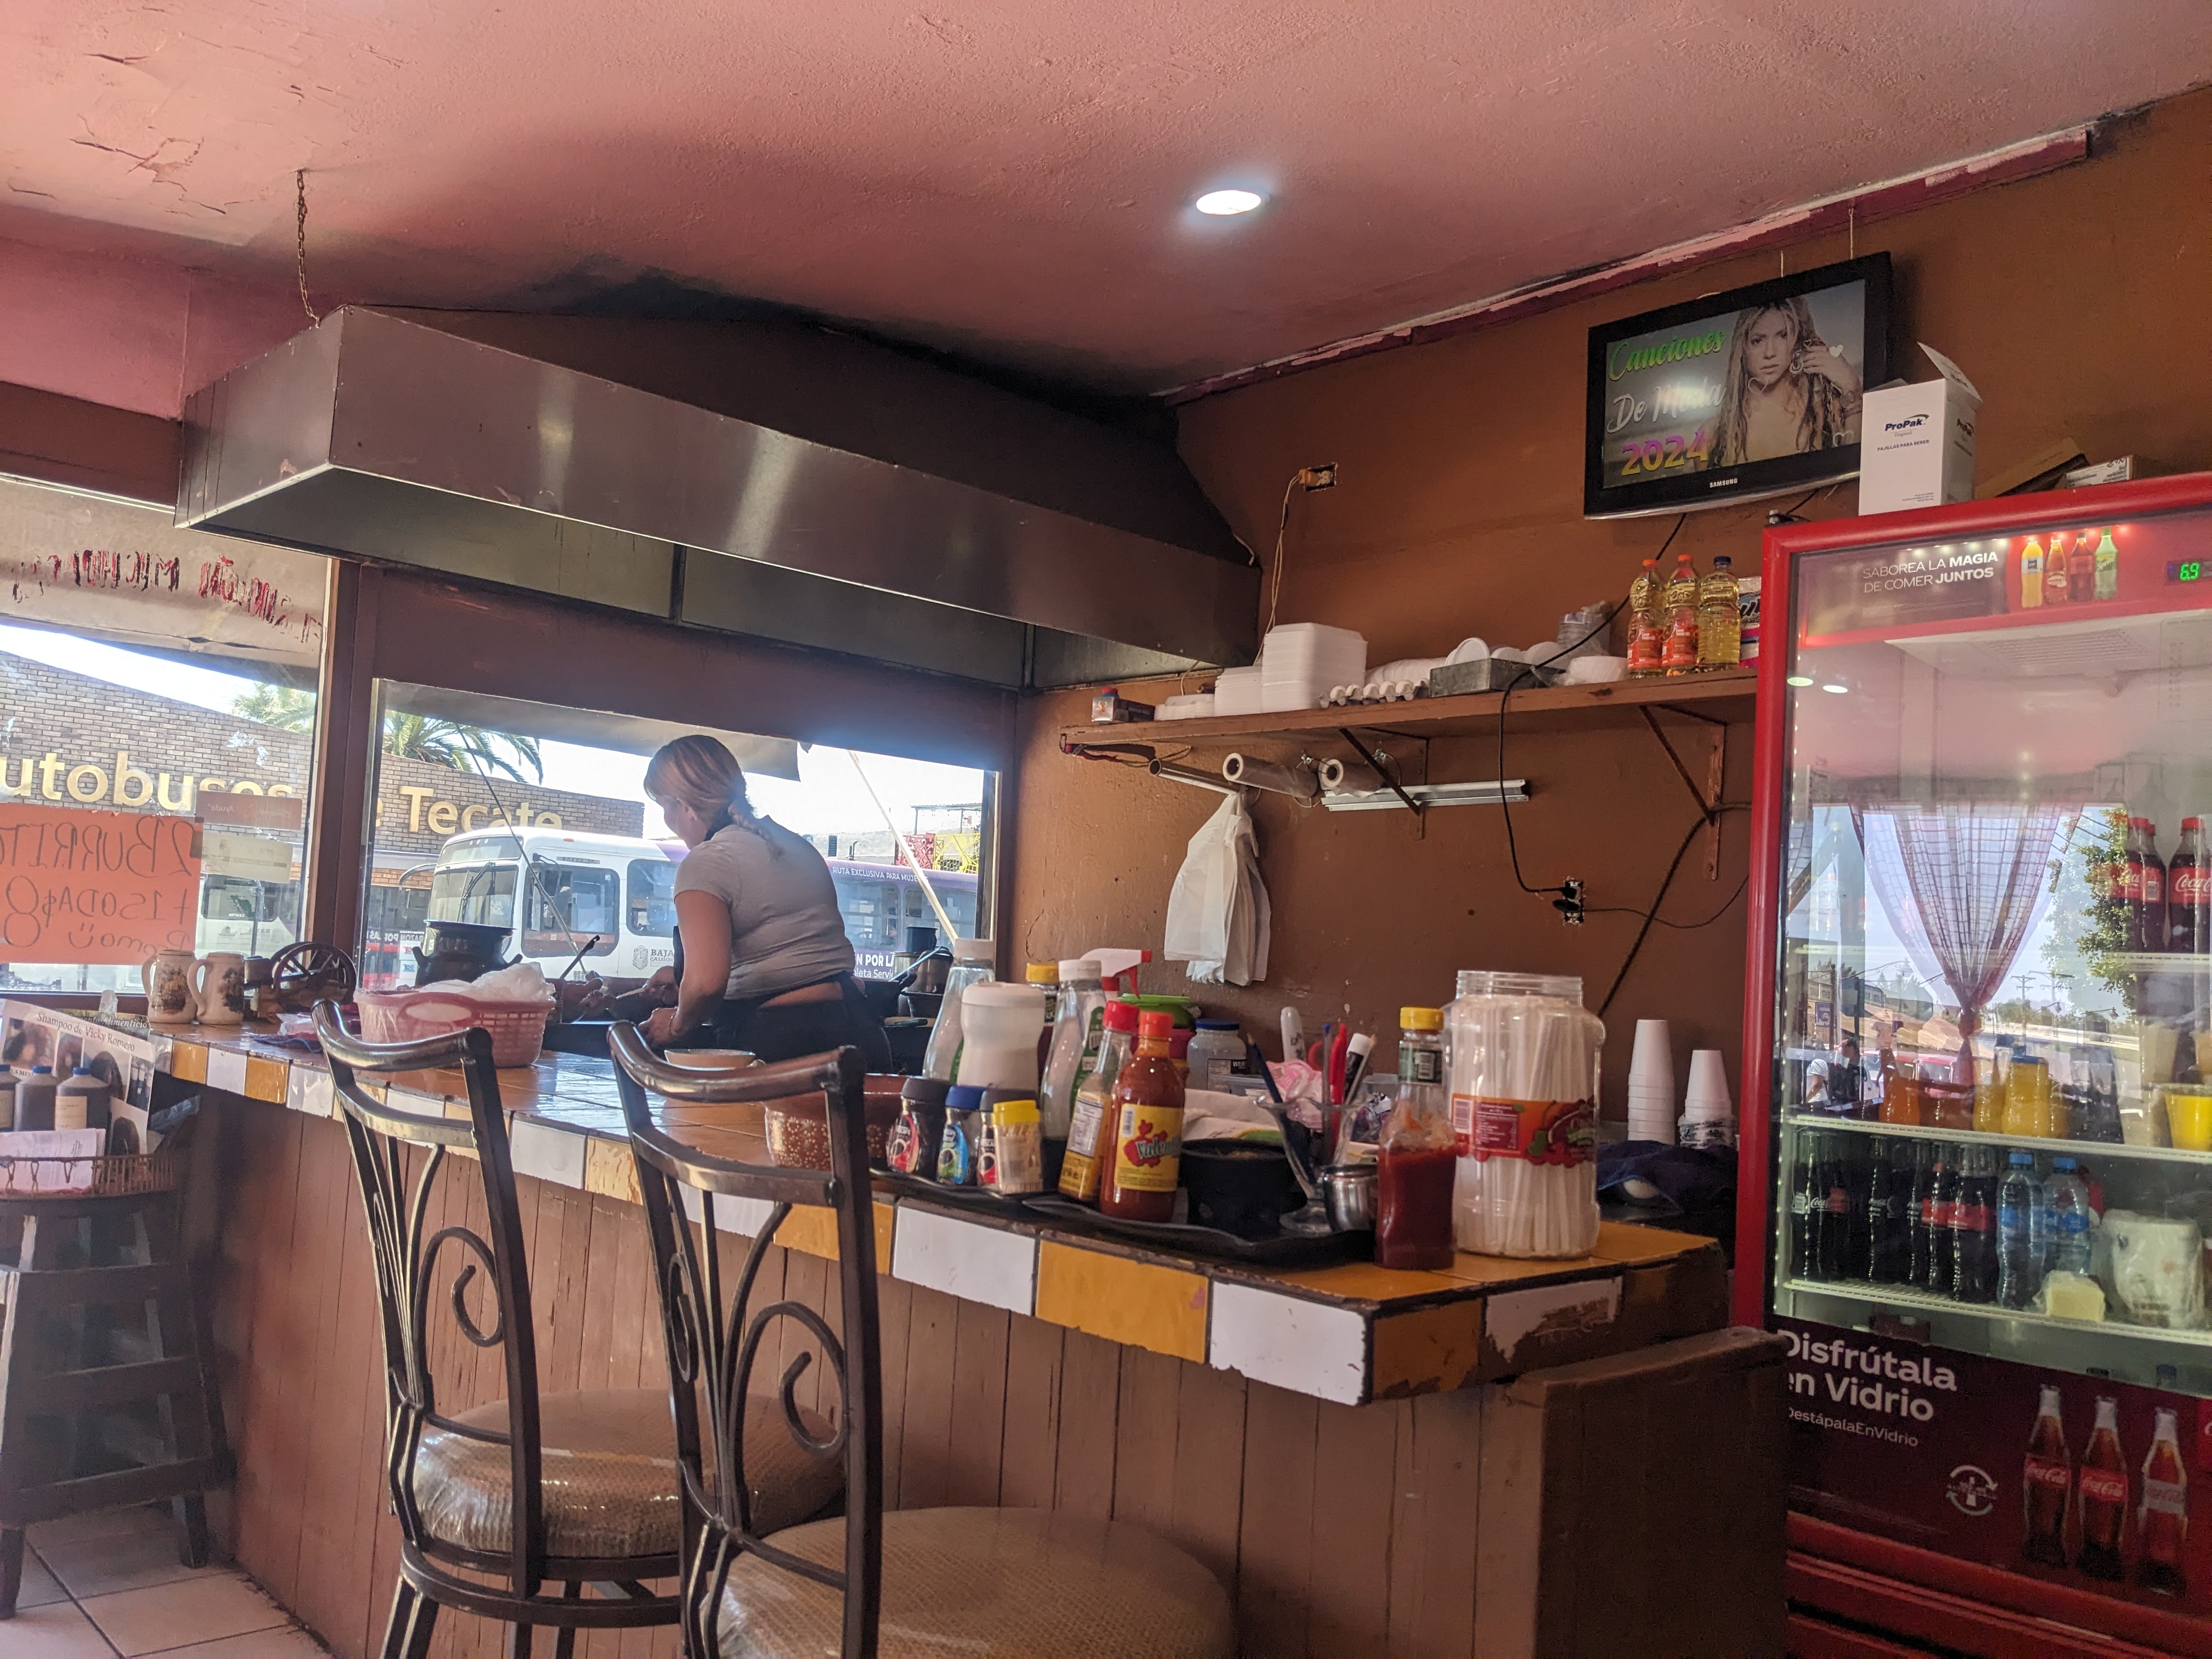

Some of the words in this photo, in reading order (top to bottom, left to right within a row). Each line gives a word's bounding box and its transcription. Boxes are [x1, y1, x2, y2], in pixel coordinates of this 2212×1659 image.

[1609, 329, 1726, 381] Canciones
[1606, 393, 1647, 434] De
[1651, 376, 1727, 423] Moda
[1884, 417, 1924, 432] ProPak
[1620, 430, 1710, 477] 2024
[1709, 478, 1738, 489] SAMSUNG
[1863, 561, 1926, 579] SABOREA
[1928, 558, 1946, 571] LA
[1949, 552, 1999, 568] MAGIA
[1864, 582, 1882, 593] DE
[1884, 575, 1933, 590] COMER
[1935, 567, 1994, 584] JUNTOS
[399, 785, 563, 835] Tecate
[832, 866, 850, 875] RUTA
[851, 868, 885, 879] EXCLUSIVA
[901, 874, 929, 883] MUJE
[651, 949, 674, 957] BAJA
[865, 954, 884, 967] POR
[37, 1012, 72, 1032] Shampoo
[74, 1023, 83, 1035] de
[85, 1026, 106, 1043] Vicky
[107, 1032, 136, 1052] Romero
[102, 1014, 148, 1029] Alimenticio
[1778, 1329, 1957, 1392] Disfrútala
[1825, 1373, 1934, 1421] Vidrio
